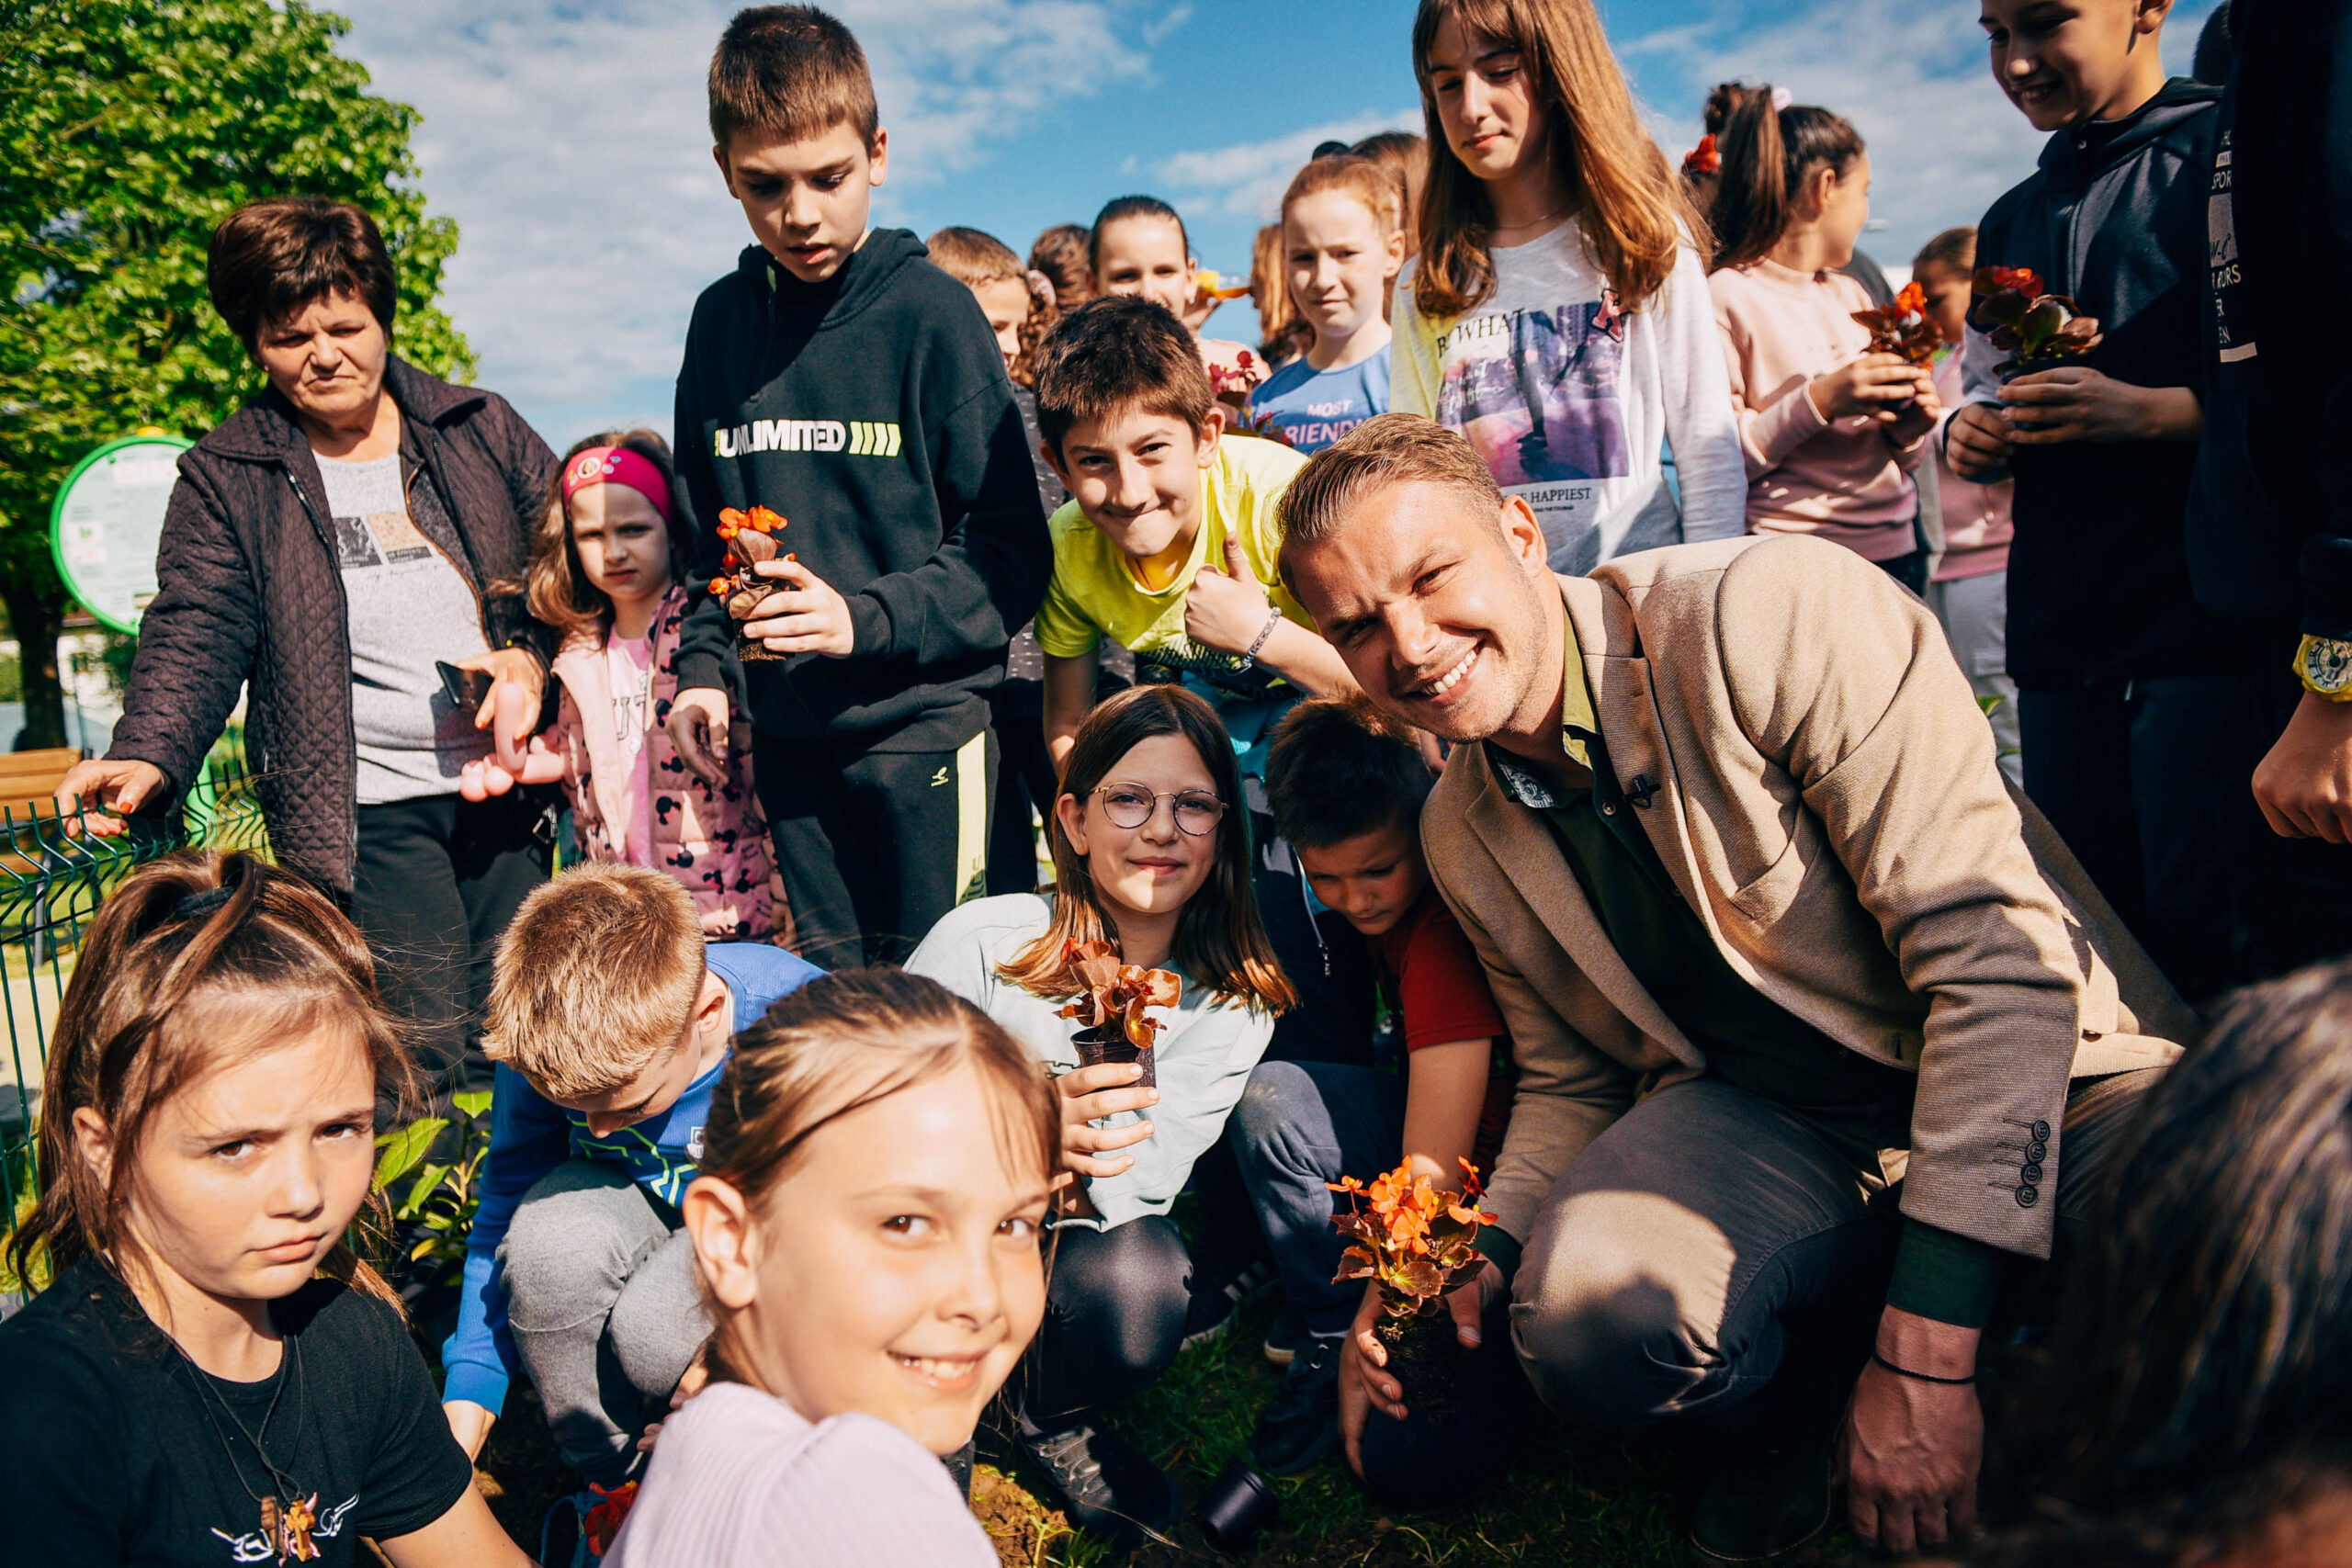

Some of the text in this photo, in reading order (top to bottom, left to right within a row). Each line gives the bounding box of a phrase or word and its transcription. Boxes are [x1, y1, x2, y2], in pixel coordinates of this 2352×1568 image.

[1456, 308, 1525, 344] WHAT
[1307, 400, 1353, 417] MOST
[718, 419, 846, 458] UNLIMITED
[1284, 419, 1365, 445] RIEND
[1531, 487, 1592, 504] HAPPIEST
